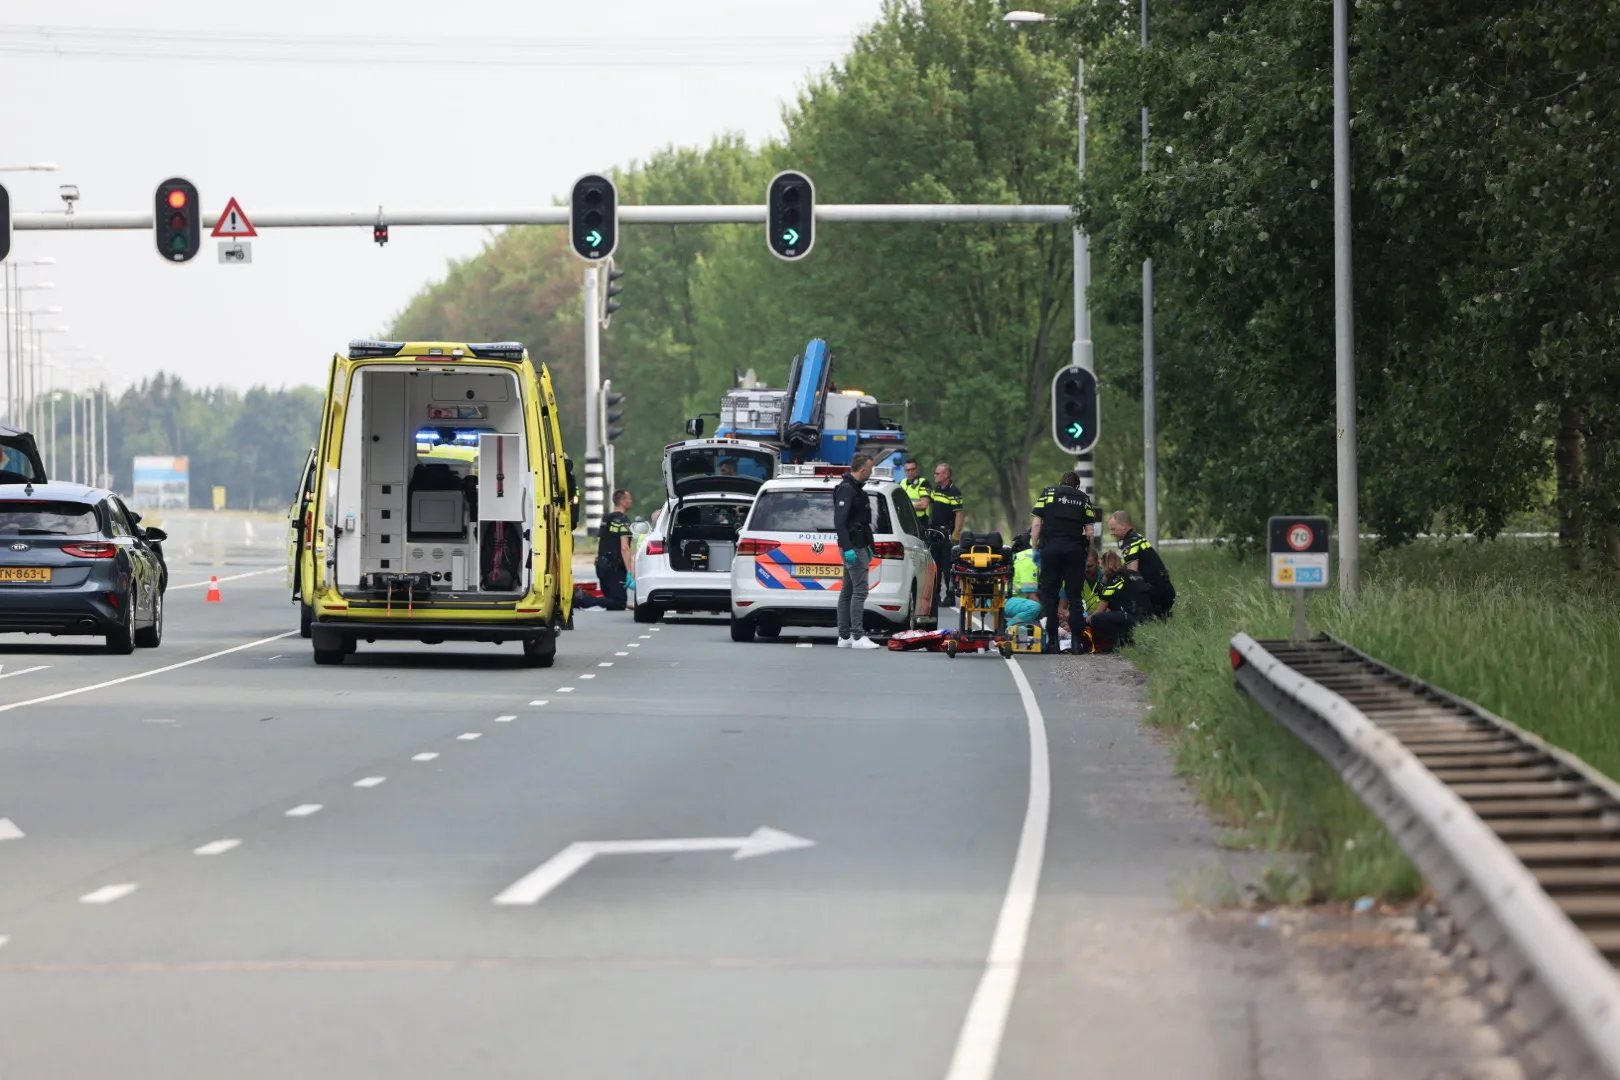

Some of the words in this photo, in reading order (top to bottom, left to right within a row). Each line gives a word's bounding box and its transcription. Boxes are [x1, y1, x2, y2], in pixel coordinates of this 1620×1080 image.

[1292, 532, 1308, 543] 70
[0, 569, 47, 578] TN-863-L
[799, 565, 841, 575] RR-155-D
